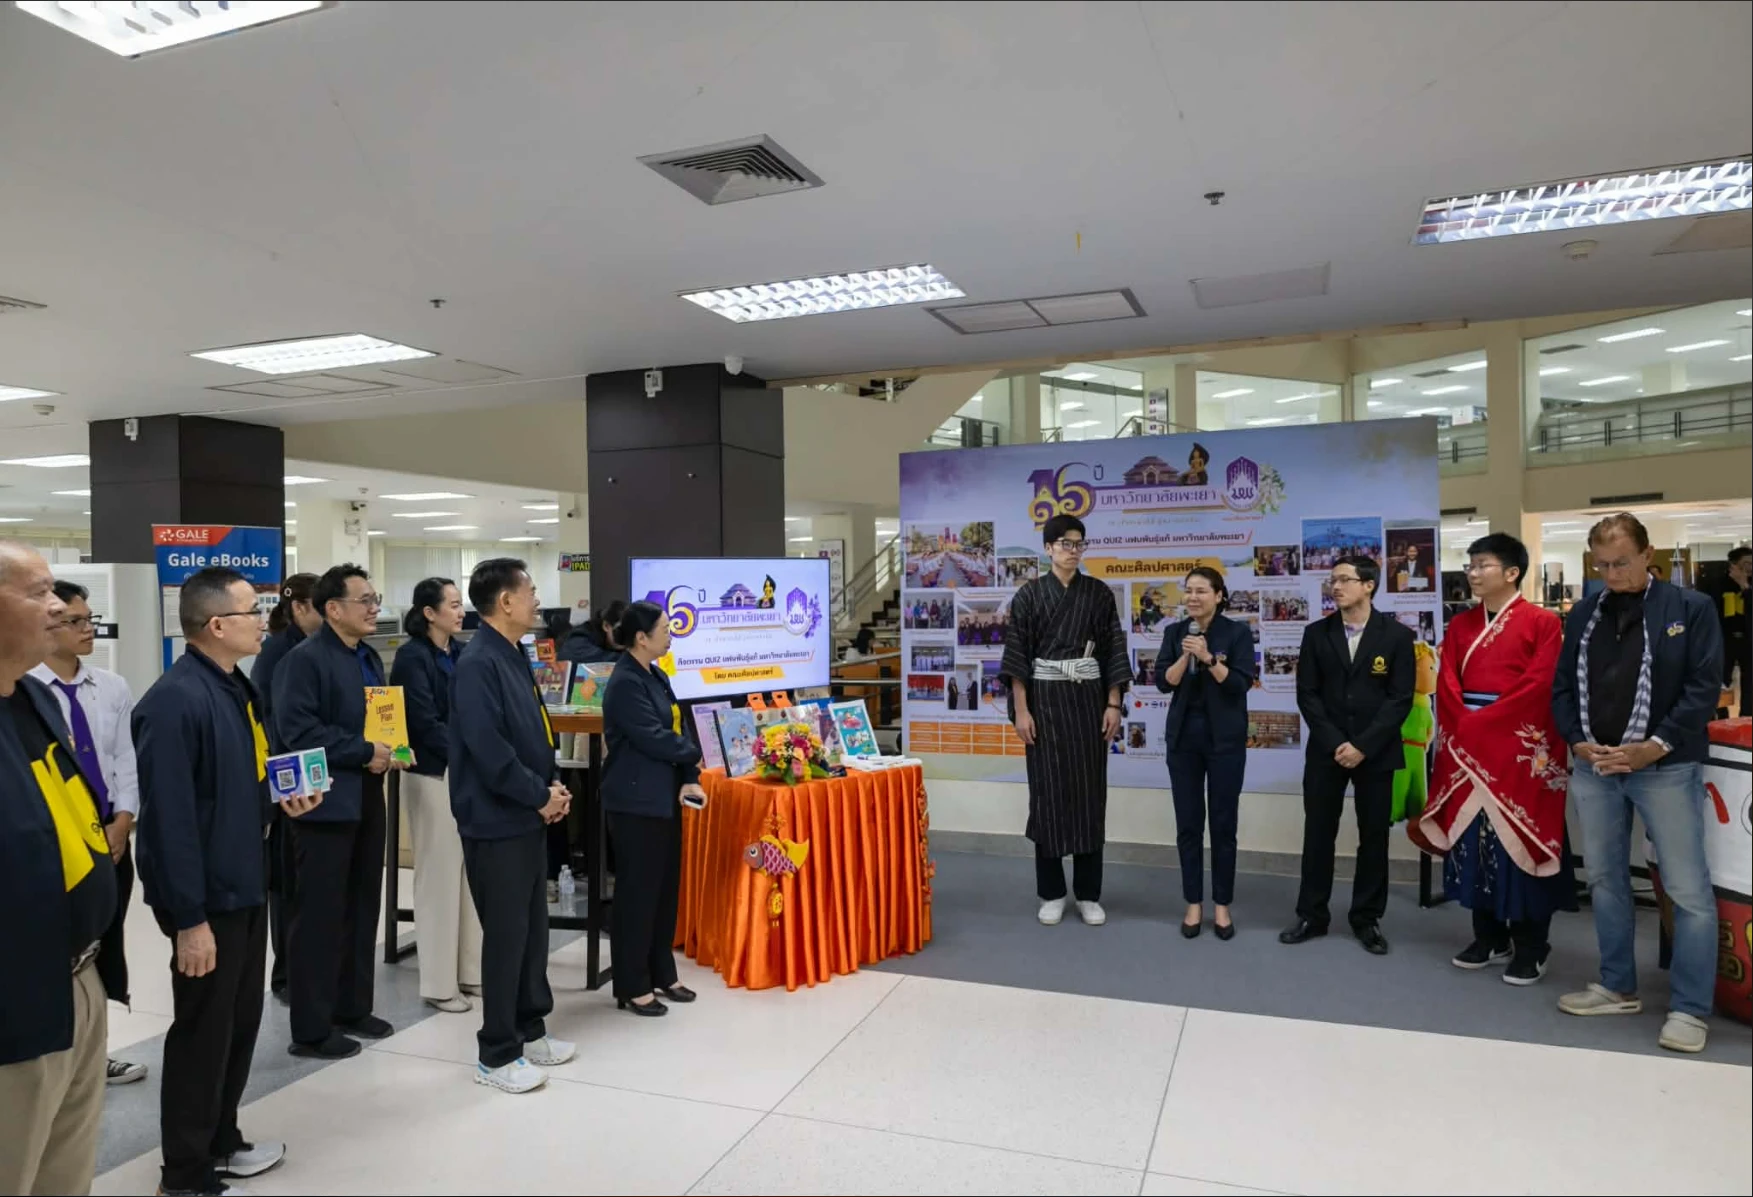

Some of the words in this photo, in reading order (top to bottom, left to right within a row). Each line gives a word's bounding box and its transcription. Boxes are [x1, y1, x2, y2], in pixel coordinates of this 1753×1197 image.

[1101, 488, 1216, 507] มหาวิทยาลัยพะเยา
[176, 529, 209, 539] GALE
[1103, 537, 1123, 545] QUIZ
[1172, 531, 1246, 544] มหาวิทยาลัยพะเยา
[168, 552, 206, 567] Gale
[210, 553, 269, 567] eBooks
[702, 610, 781, 626] มหาวิทยาลัยพะเยา
[705, 655, 721, 664] QUIZ
[376, 703, 395, 715] Lesson
[381, 713, 393, 723] Plan
